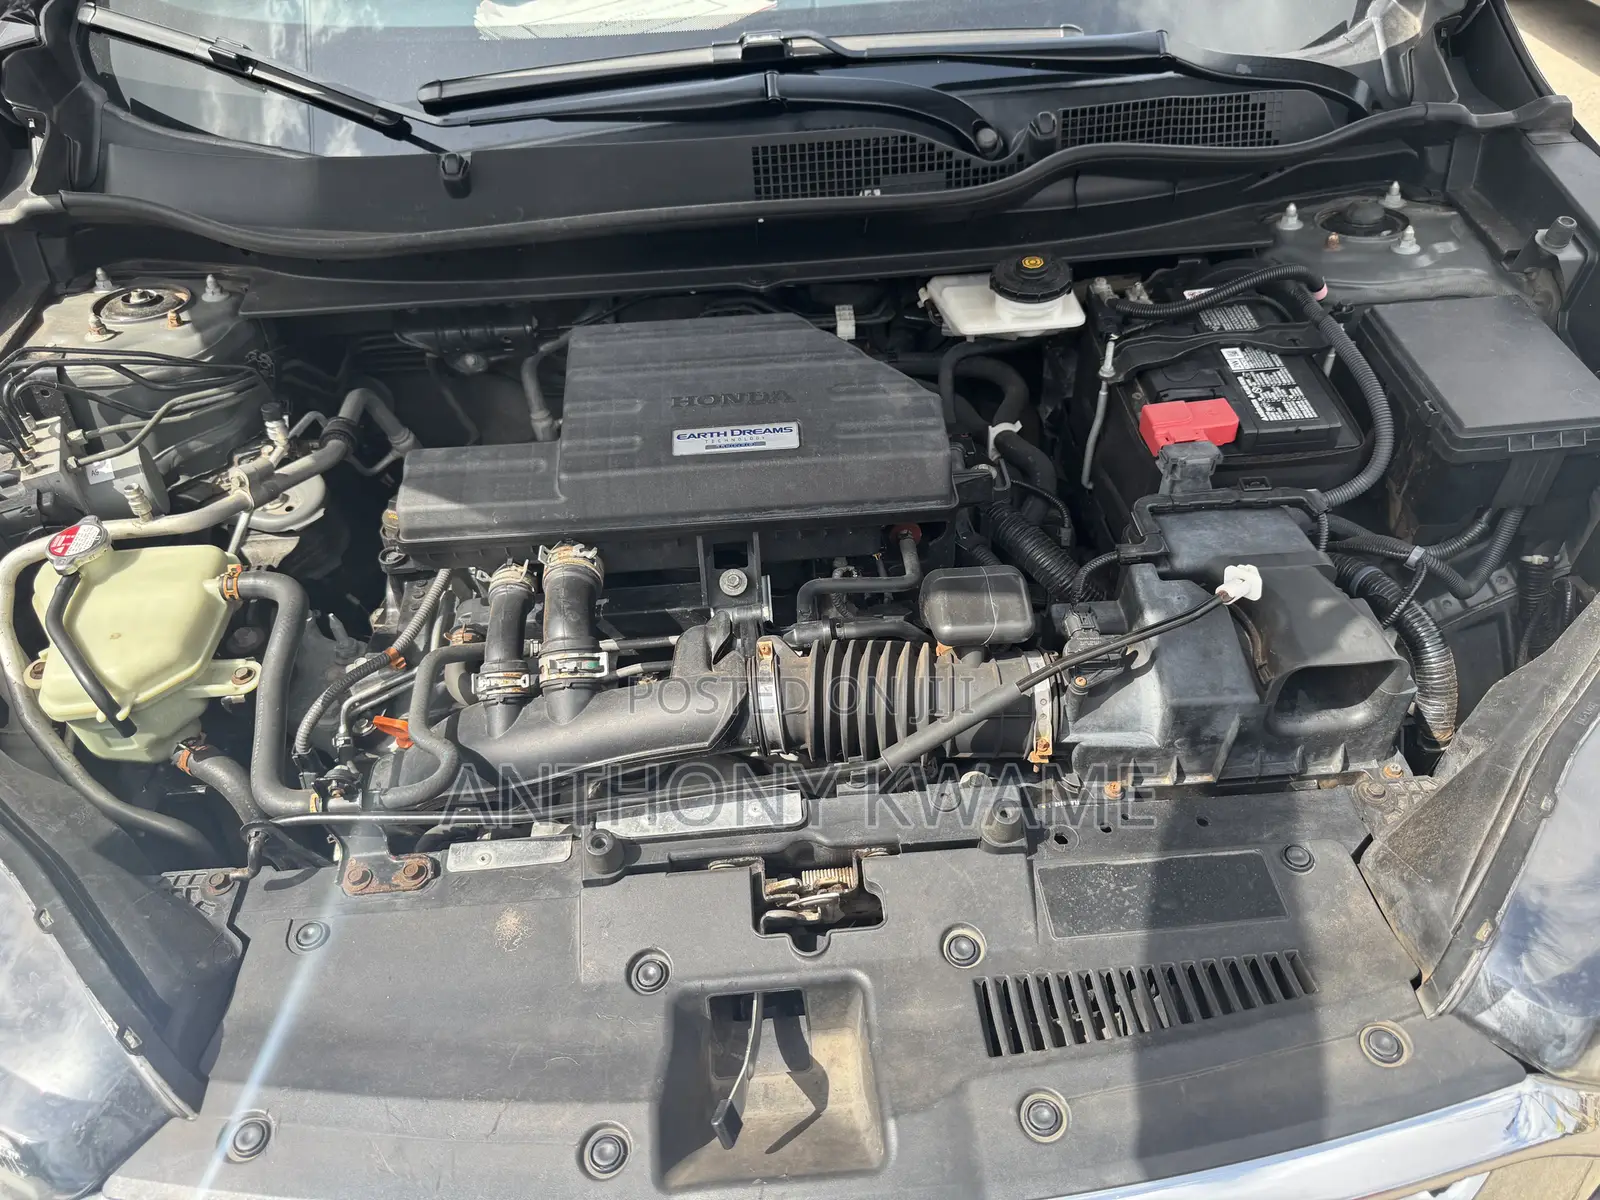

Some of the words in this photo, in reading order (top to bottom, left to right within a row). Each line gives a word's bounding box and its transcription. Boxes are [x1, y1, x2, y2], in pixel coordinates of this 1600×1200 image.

[671, 390, 797, 408] HONDA
[676, 430, 728, 441] EARTH
[730, 426, 794, 438] DREAMS
